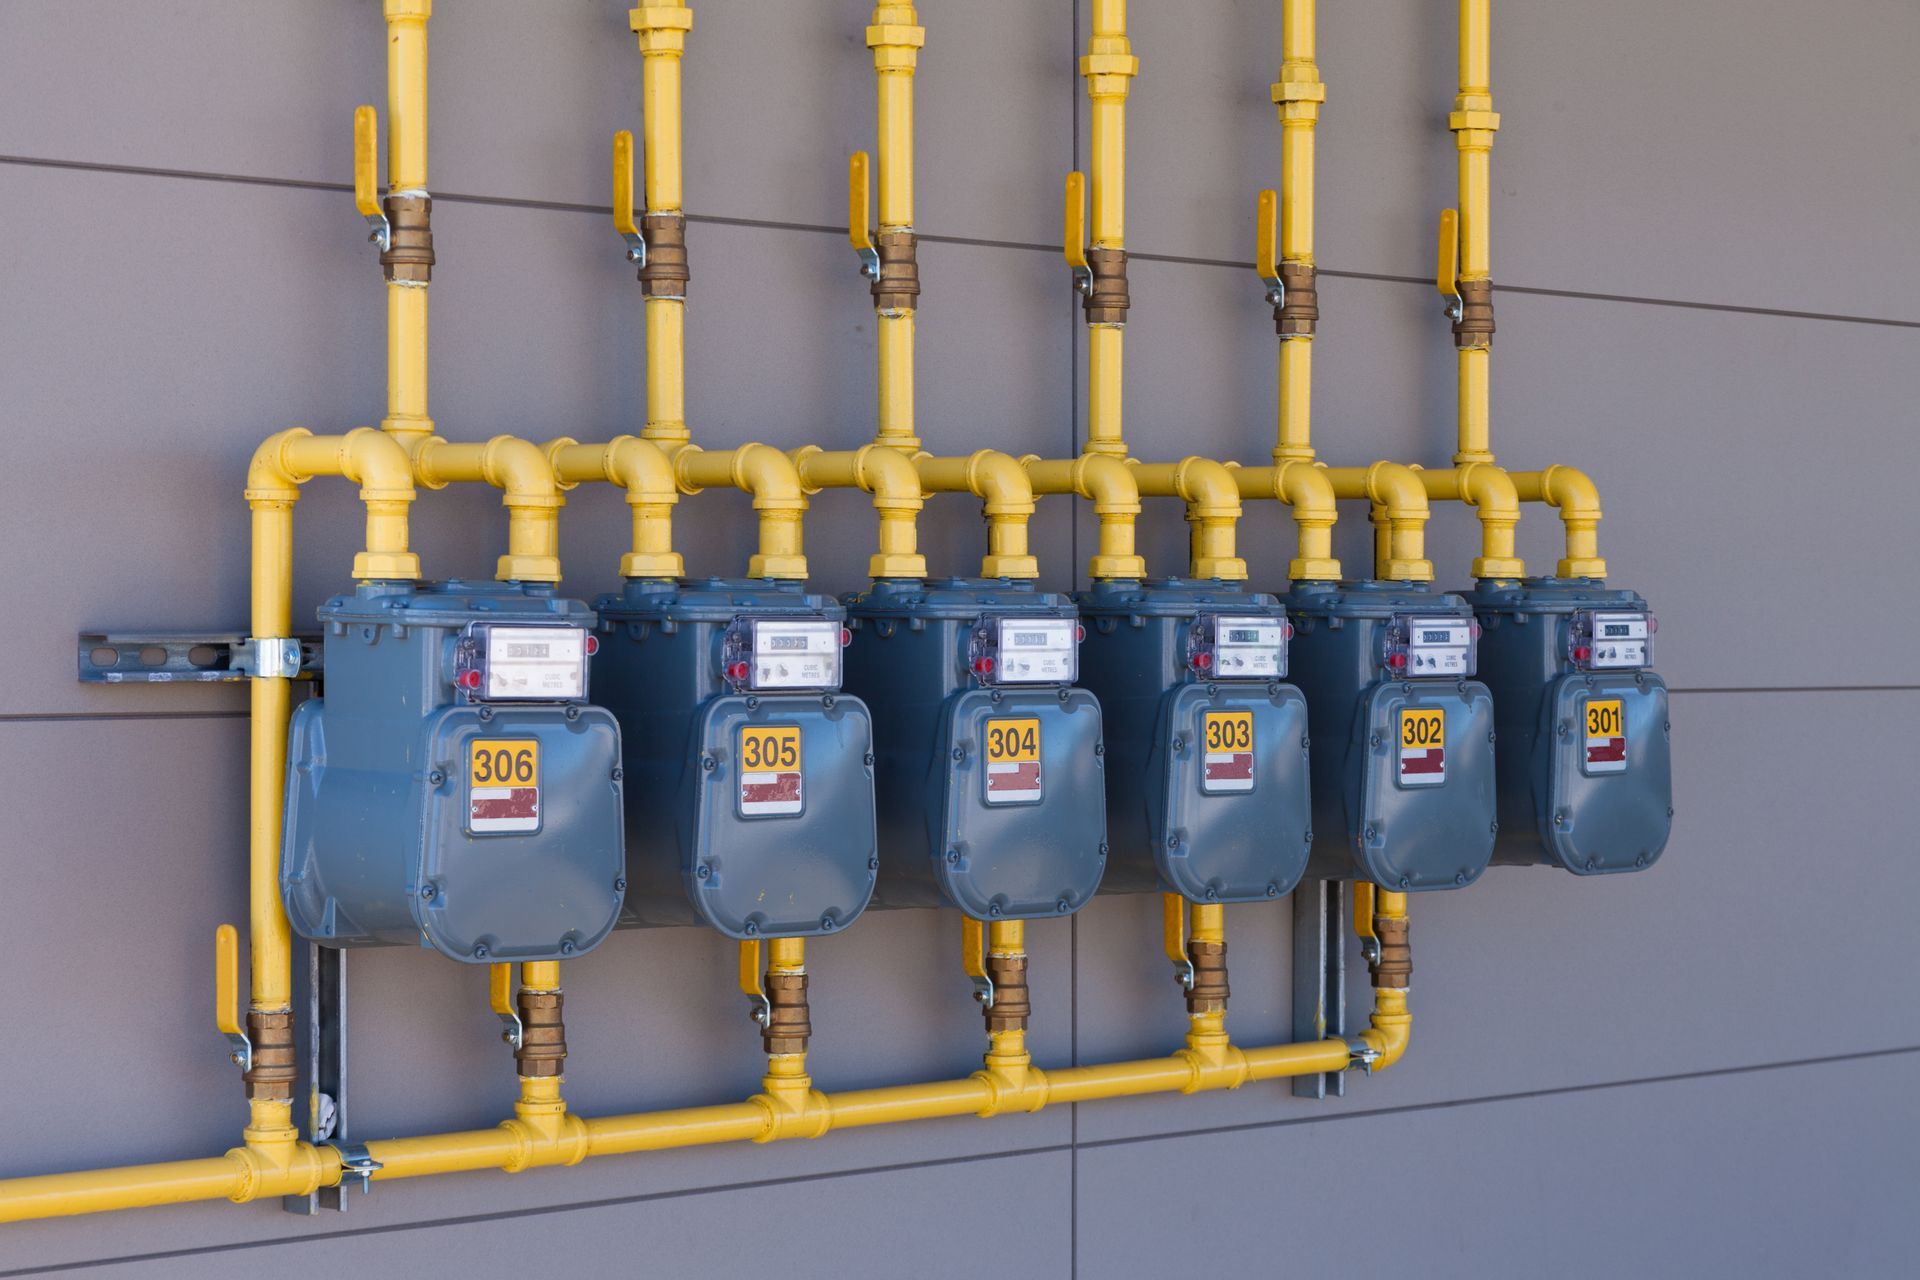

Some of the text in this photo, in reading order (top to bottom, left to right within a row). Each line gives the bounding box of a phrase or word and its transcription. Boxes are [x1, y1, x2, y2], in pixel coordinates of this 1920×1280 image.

[1208, 719, 1250, 749] 303
[1403, 717, 1441, 745] 302
[1588, 707, 1619, 734] 301
[744, 736, 796, 767] 305
[989, 727, 1036, 758] 304
[474, 749, 533, 782] 306
